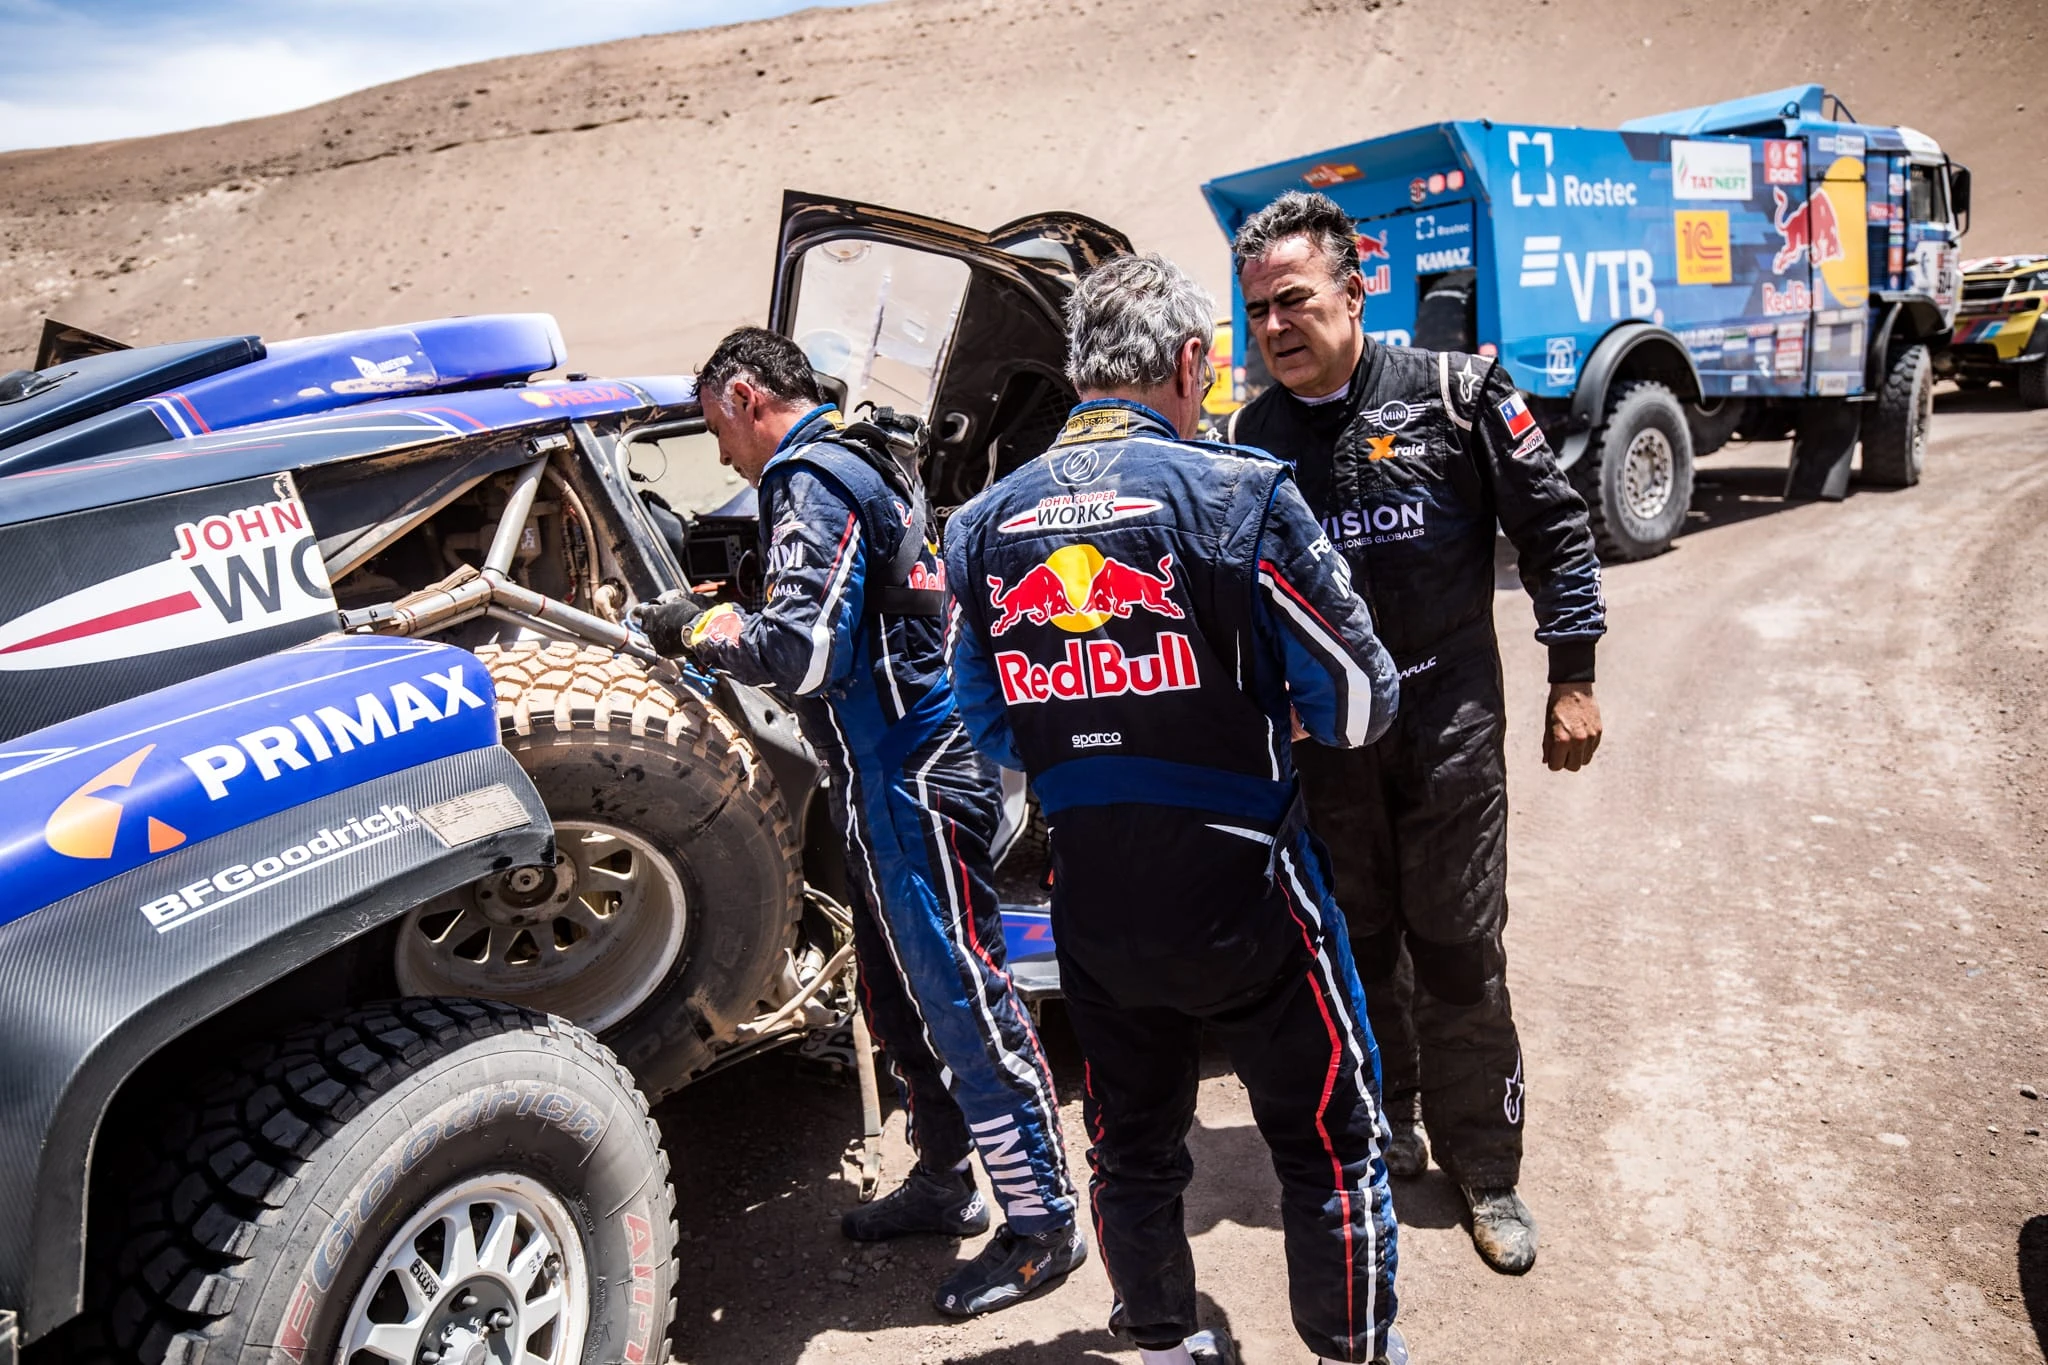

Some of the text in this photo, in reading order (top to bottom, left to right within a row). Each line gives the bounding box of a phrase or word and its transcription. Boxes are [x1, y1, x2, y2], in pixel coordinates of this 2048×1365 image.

[1563, 174, 1638, 207] Rostec
[1690, 175, 1747, 190] TATNEFT
[1416, 247, 1471, 272] KAMAZ
[1362, 264, 1391, 296] ull
[1563, 249, 1657, 323] VTB
[1762, 280, 1794, 316] Red
[543, 386, 632, 407] HELIX
[1382, 410, 1407, 421] MINI
[1036, 501, 1115, 526] WORKS
[1037, 491, 1116, 509] JOHN COOPER
[181, 502, 303, 561] JOHN
[1321, 501, 1425, 540] ISION
[1374, 528, 1425, 544] GLOBALES
[994, 631, 1201, 706] Red Bull
[181, 664, 486, 801] PRIMAX
[1071, 731, 1122, 749] sparco
[396, 820, 421, 834] Tires
[139, 803, 415, 927] BFGoodrich
[969, 1113, 1050, 1217] MINI
